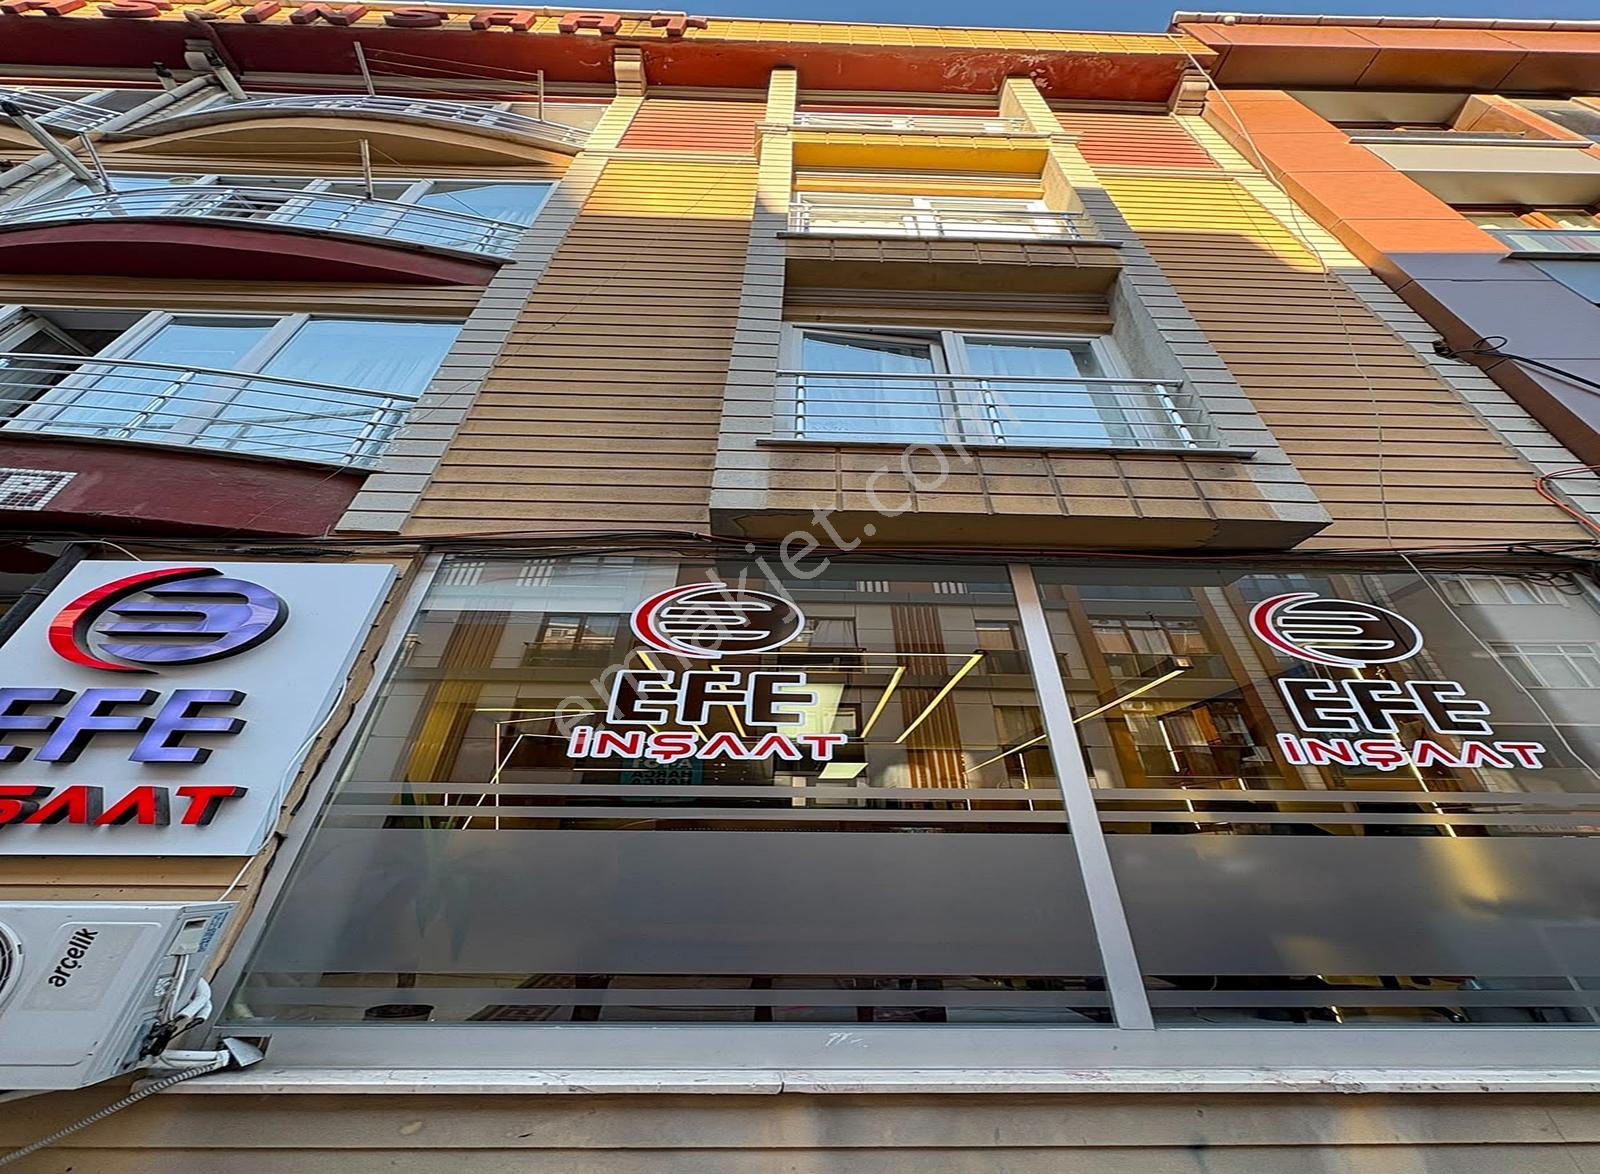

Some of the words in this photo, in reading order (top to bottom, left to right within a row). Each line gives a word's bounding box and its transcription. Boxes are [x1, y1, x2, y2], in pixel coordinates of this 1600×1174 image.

[606, 670, 818, 726] EFE
[1277, 678, 1494, 735] EFE
[567, 725, 847, 764] İNŞAAT
[1276, 731, 1547, 771] İNŞAAT
[48, 927, 98, 988] arçelik
